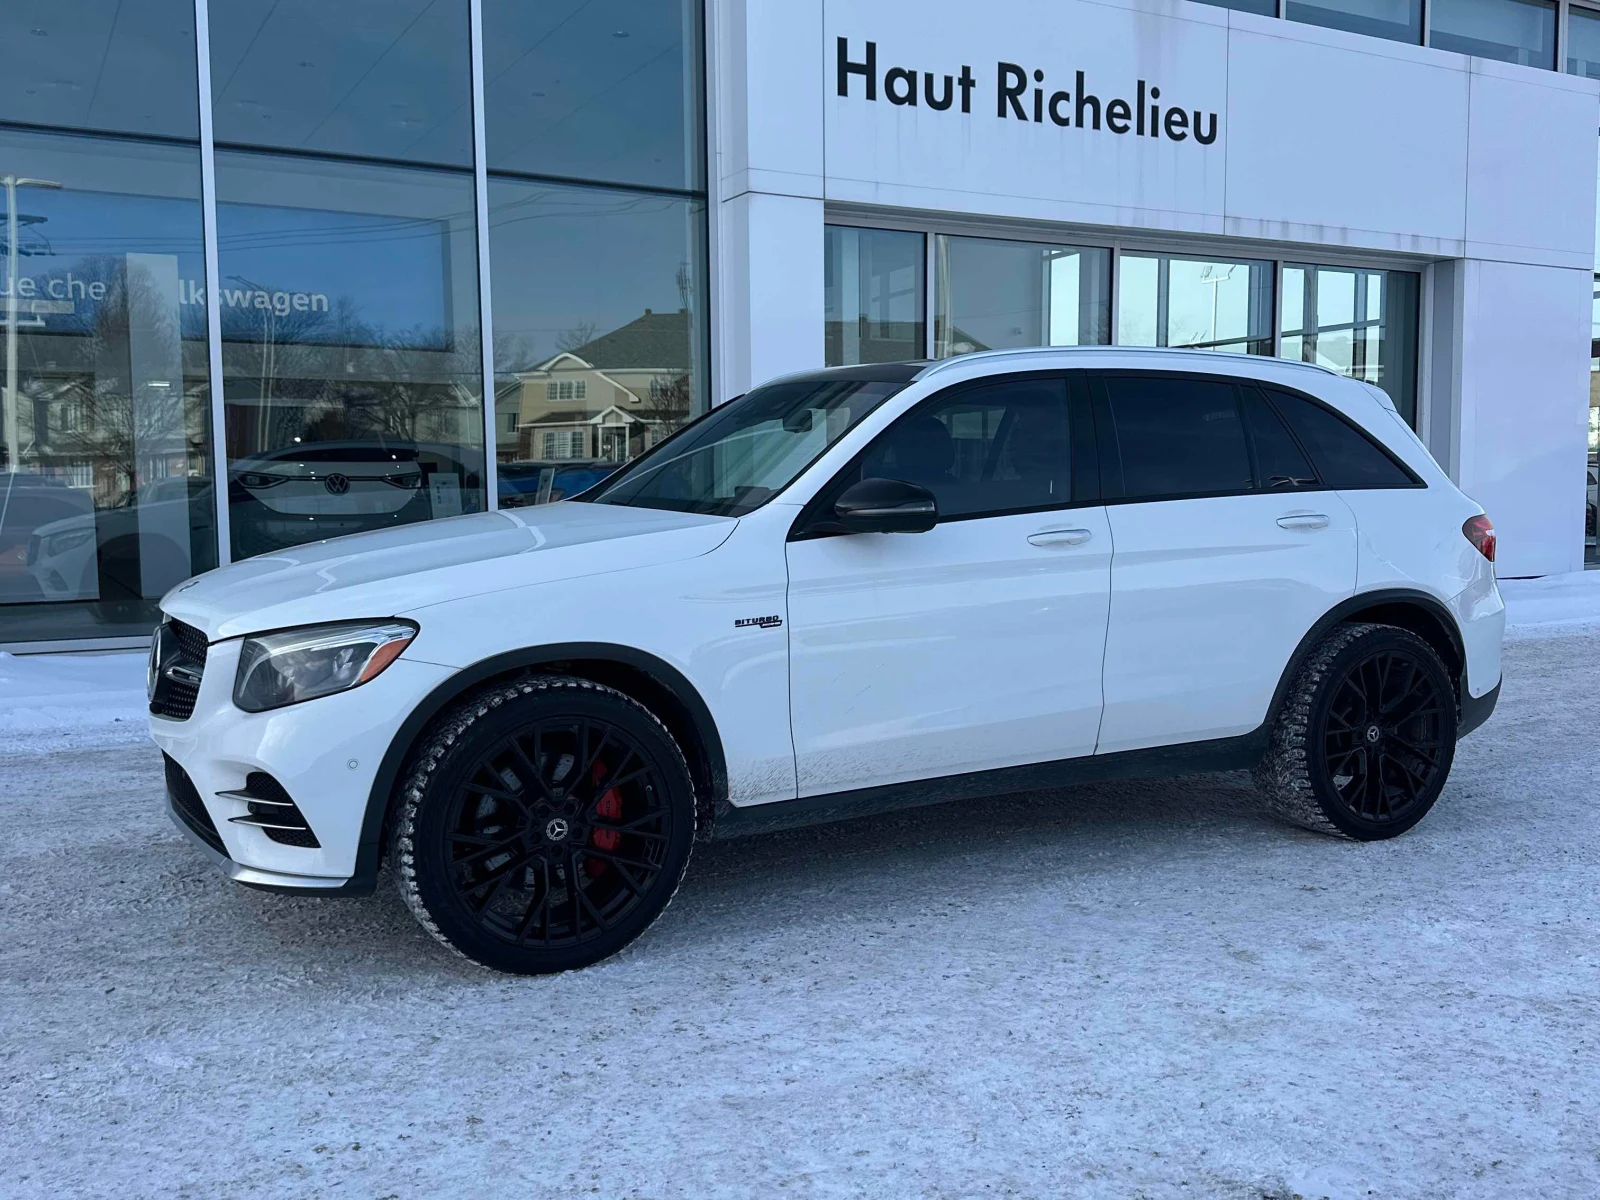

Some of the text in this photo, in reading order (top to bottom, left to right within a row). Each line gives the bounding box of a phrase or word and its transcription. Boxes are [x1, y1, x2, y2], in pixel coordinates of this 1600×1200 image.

[837, 36, 1217, 145] Haut Richelieu
[179, 279, 328, 316] lkwagen
